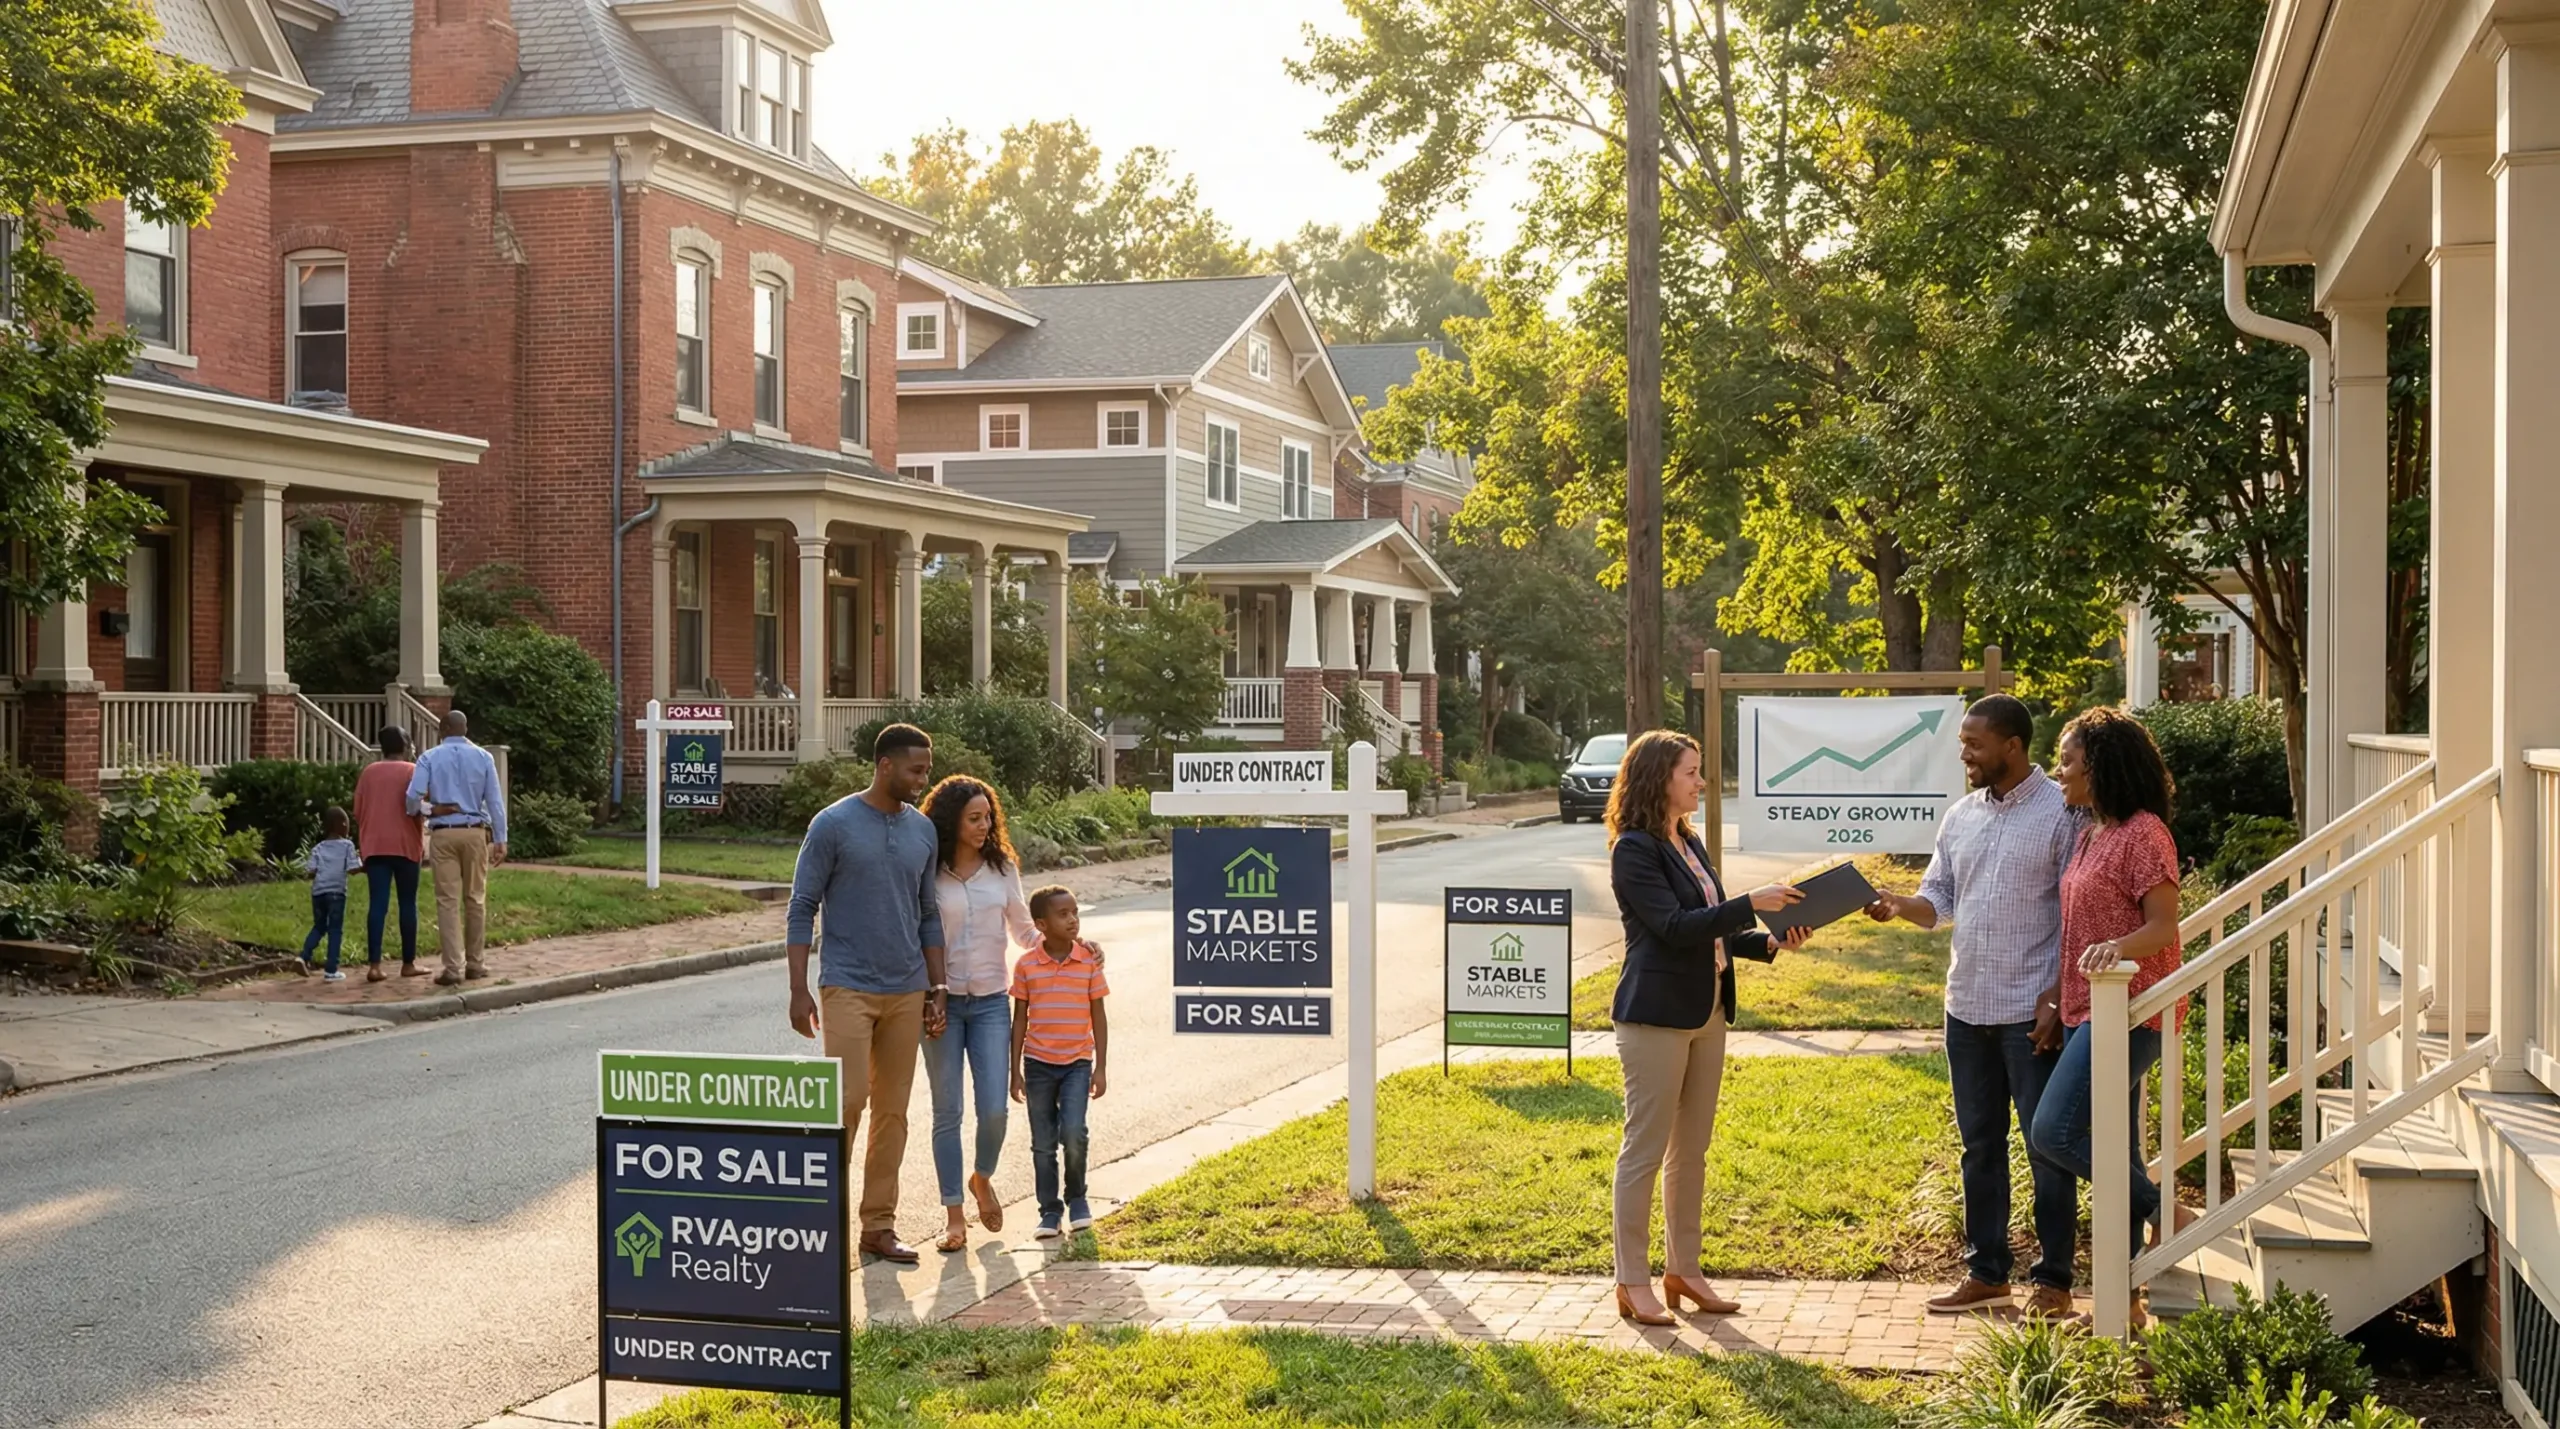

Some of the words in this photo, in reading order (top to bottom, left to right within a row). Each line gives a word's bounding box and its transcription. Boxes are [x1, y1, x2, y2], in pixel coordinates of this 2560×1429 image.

[668, 707, 690, 718] FOR
[693, 707, 722, 718] SALE
[670, 762, 717, 774] STABLE
[1179, 761, 1233, 783] UNDER
[1238, 760, 1325, 782] CONTRACT
[671, 774, 717, 785] REALTY
[693, 795, 718, 805] SALE
[1767, 806, 1841, 821] STEADY
[1847, 806, 1934, 821] GROWTH
[1827, 828, 1874, 843] 2026
[1452, 897, 1498, 914] FOR
[1506, 898, 1564, 915] SALE
[1187, 908, 1318, 935] STABLE
[1187, 940, 1318, 962] MARKETS
[1467, 966, 1546, 983] STABLE
[1467, 984, 1546, 999] MARKETS
[1187, 1003, 1242, 1026] FOR
[1250, 1004, 1319, 1027] SALE
[1511, 1022, 1561, 1031] CONTRACT
[610, 1069, 692, 1104] UNDER
[700, 1073, 830, 1109] CONTRACT
[616, 1143, 704, 1180] FOR
[717, 1148, 828, 1187] SALE
[671, 1216, 828, 1254] RVAgrow
[671, 1252, 771, 1290] Realty
[614, 1337, 695, 1361] UNDER
[702, 1343, 831, 1371] CONTRACT
